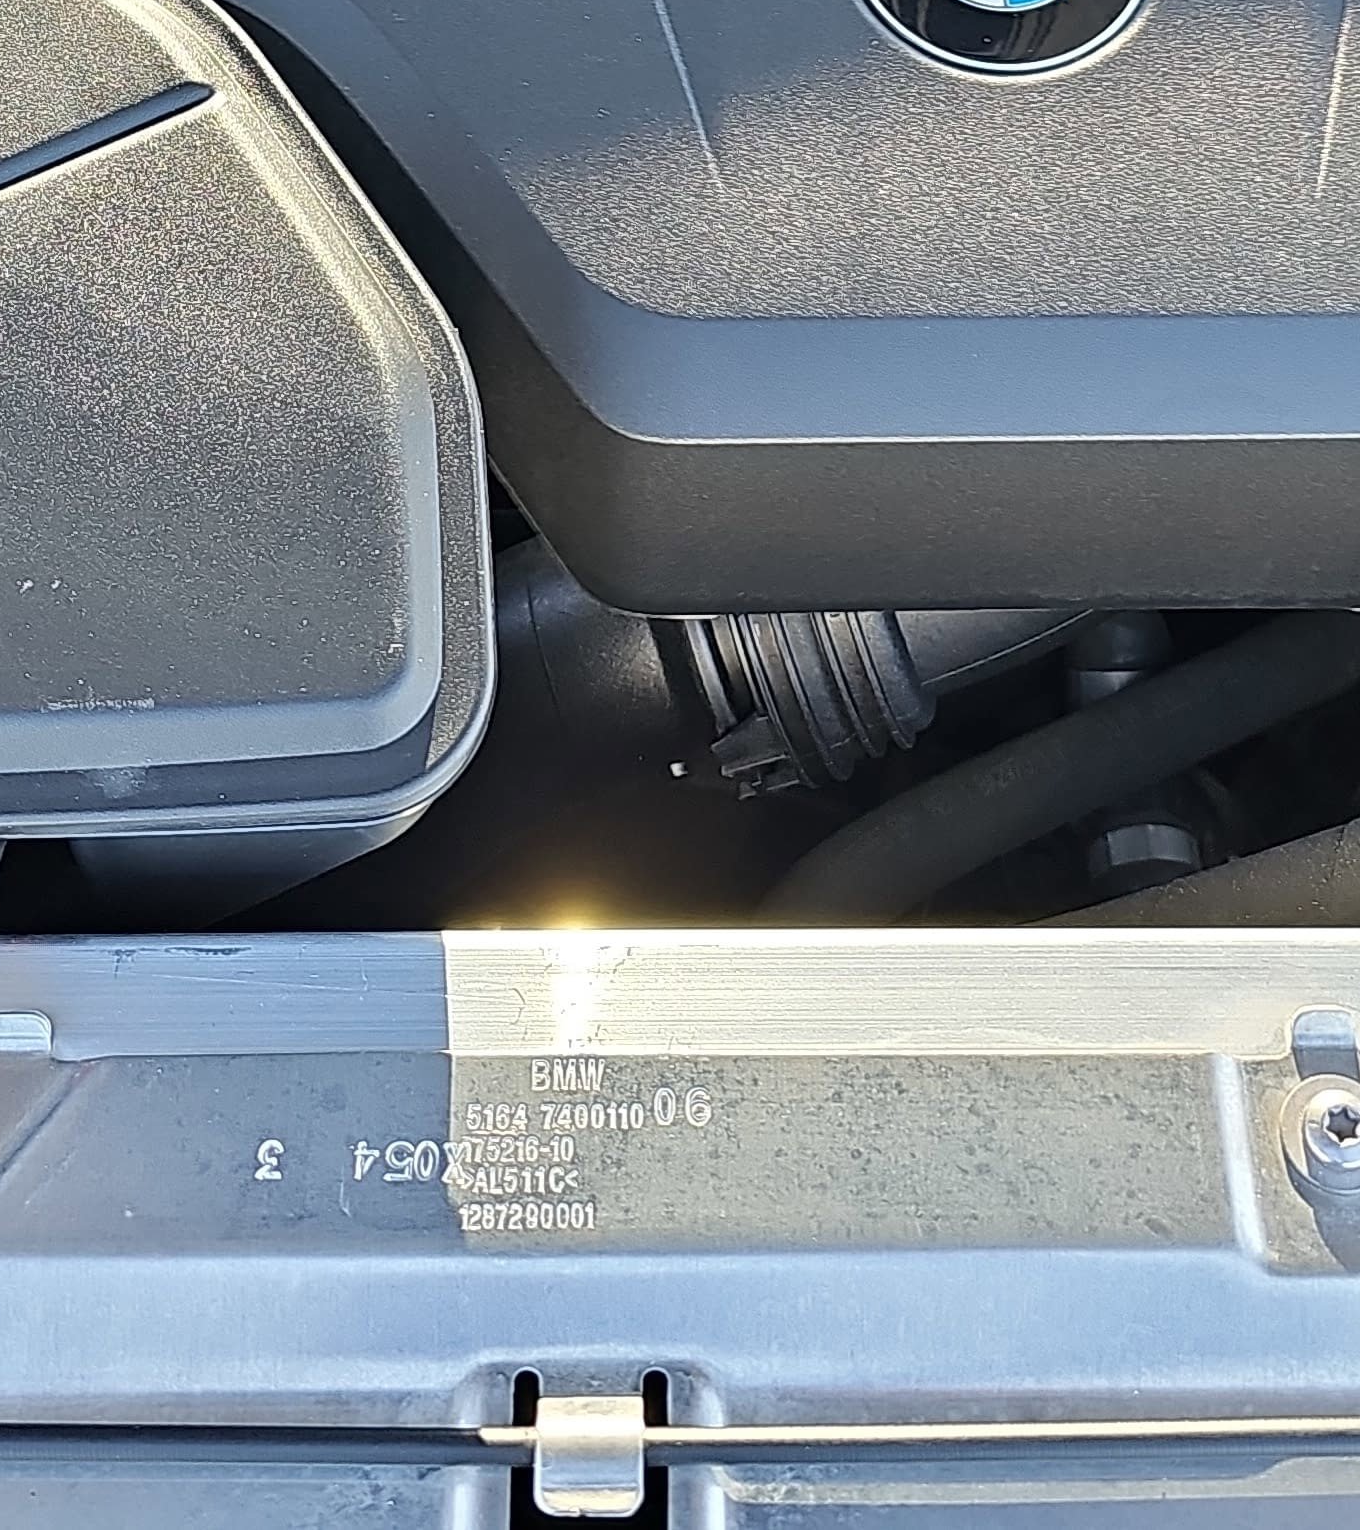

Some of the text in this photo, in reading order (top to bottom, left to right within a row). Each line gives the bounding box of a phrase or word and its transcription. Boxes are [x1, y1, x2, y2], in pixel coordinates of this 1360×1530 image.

[530, 1058, 607, 1092] BMW
[465, 1102, 645, 1131] 5164 7400110
[652, 1086, 713, 1128] 06
